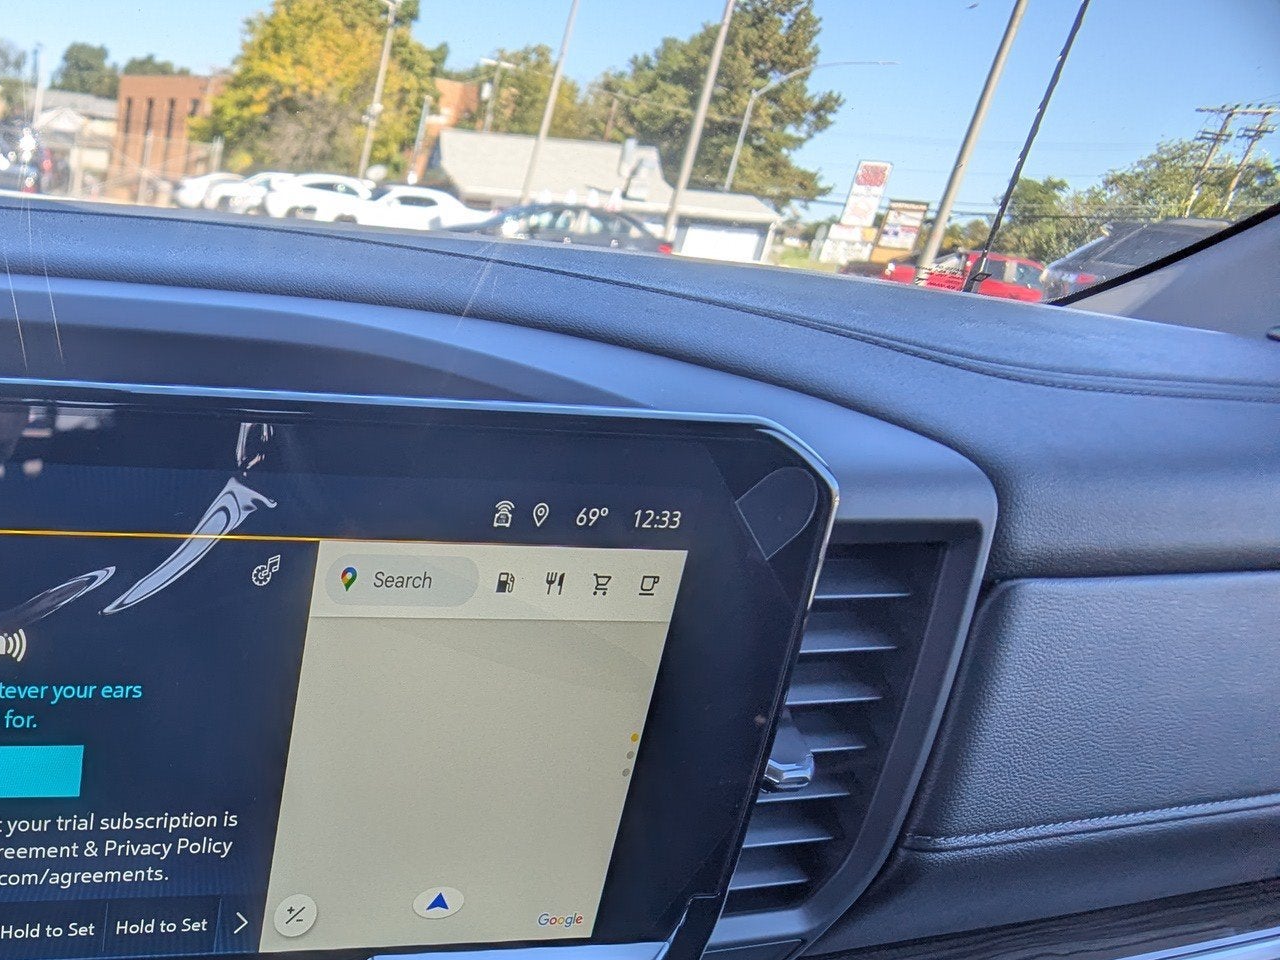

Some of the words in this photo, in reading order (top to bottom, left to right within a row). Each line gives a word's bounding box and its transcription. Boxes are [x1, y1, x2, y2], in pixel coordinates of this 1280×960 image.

[633, 509, 681, 530] 12:33
[373, 571, 432, 589] Search
[50, 685, 97, 705] your
[101, 684, 143, 699] ears
[4, 709, 37, 729] for.
[6, 818, 52, 838] your
[56, 813, 95, 832] trial
[99, 811, 218, 833] subscription
[223, 811, 239, 828] is
[84, 841, 99, 858] &
[104, 839, 173, 861] Privacy
[176, 837, 233, 858] Policy
[115, 918, 155, 936] Hold
[160, 920, 177, 933] to
[180, 917, 208, 932] Set
[538, 913, 583, 928] Google
[0, 923, 40, 940] Hold
[45, 924, 64, 938] to
[68, 922, 95, 937] Set
